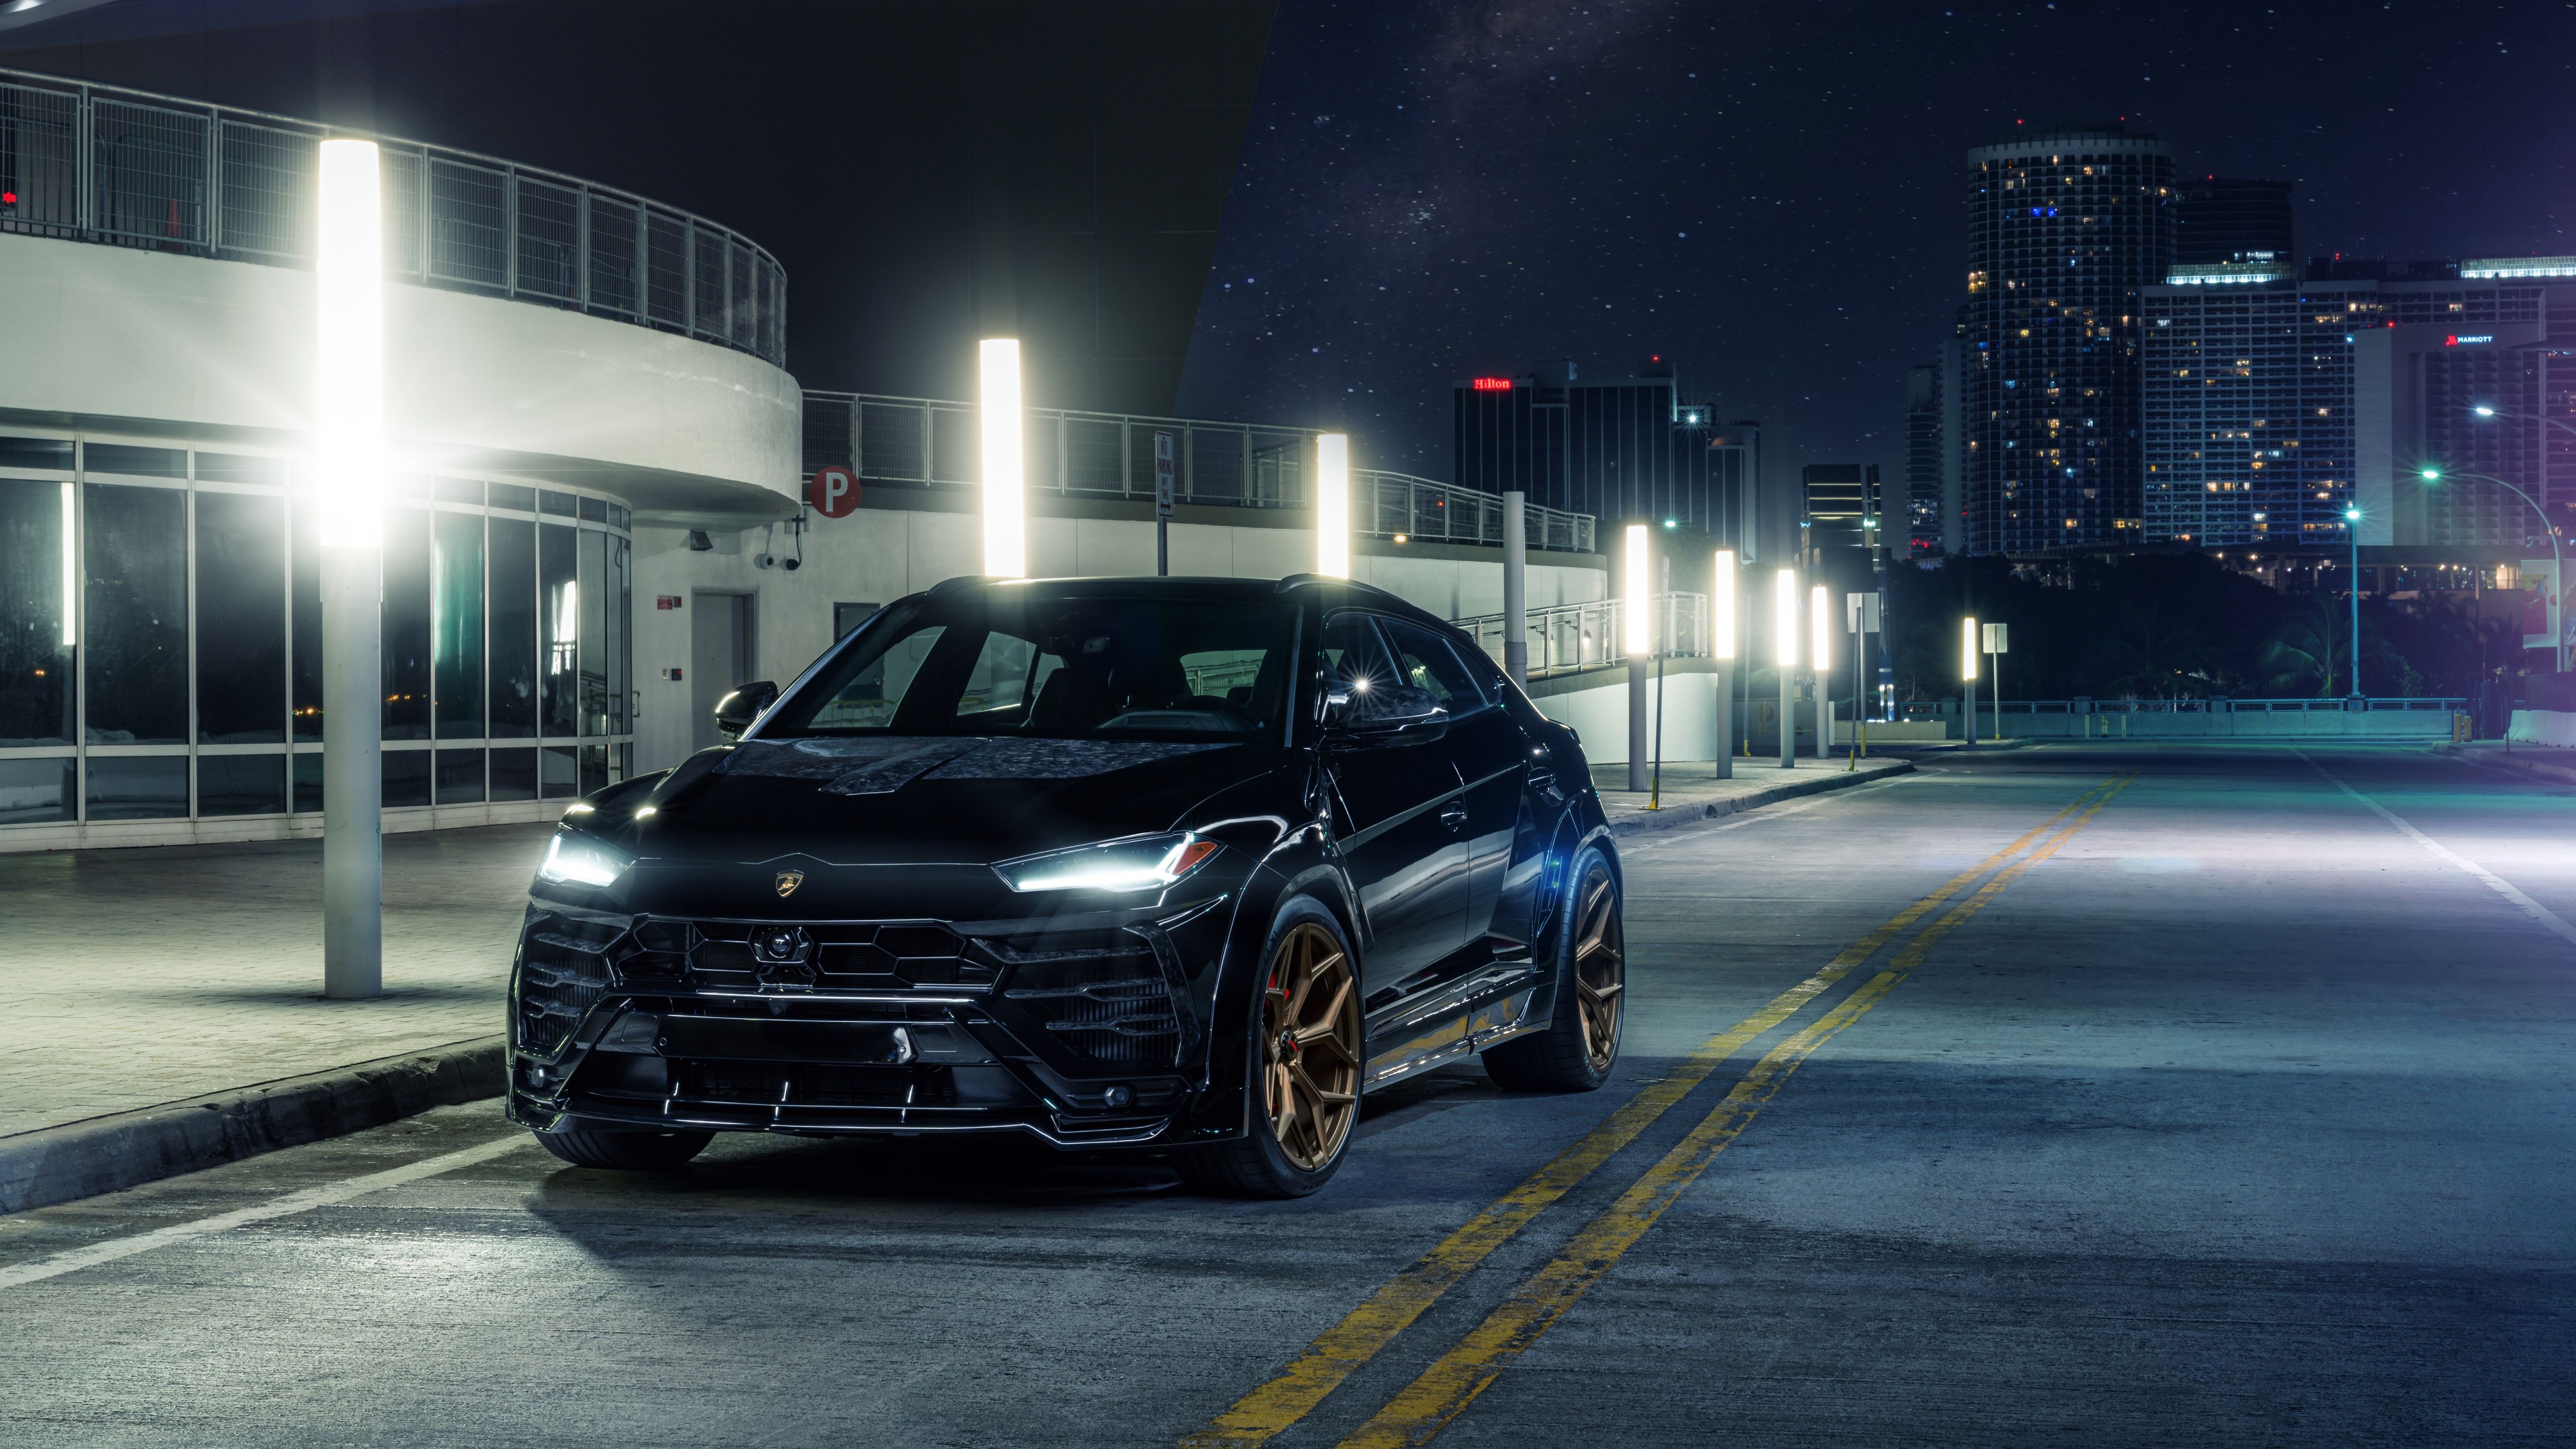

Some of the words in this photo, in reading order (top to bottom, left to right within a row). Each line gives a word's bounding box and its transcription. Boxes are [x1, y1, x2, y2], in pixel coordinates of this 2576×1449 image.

[1475, 379, 1509, 388] Hilton
[1161, 440, 1167, 455] NO
[1158, 458, 1172, 475] PARKING
[826, 472, 848, 512] P
